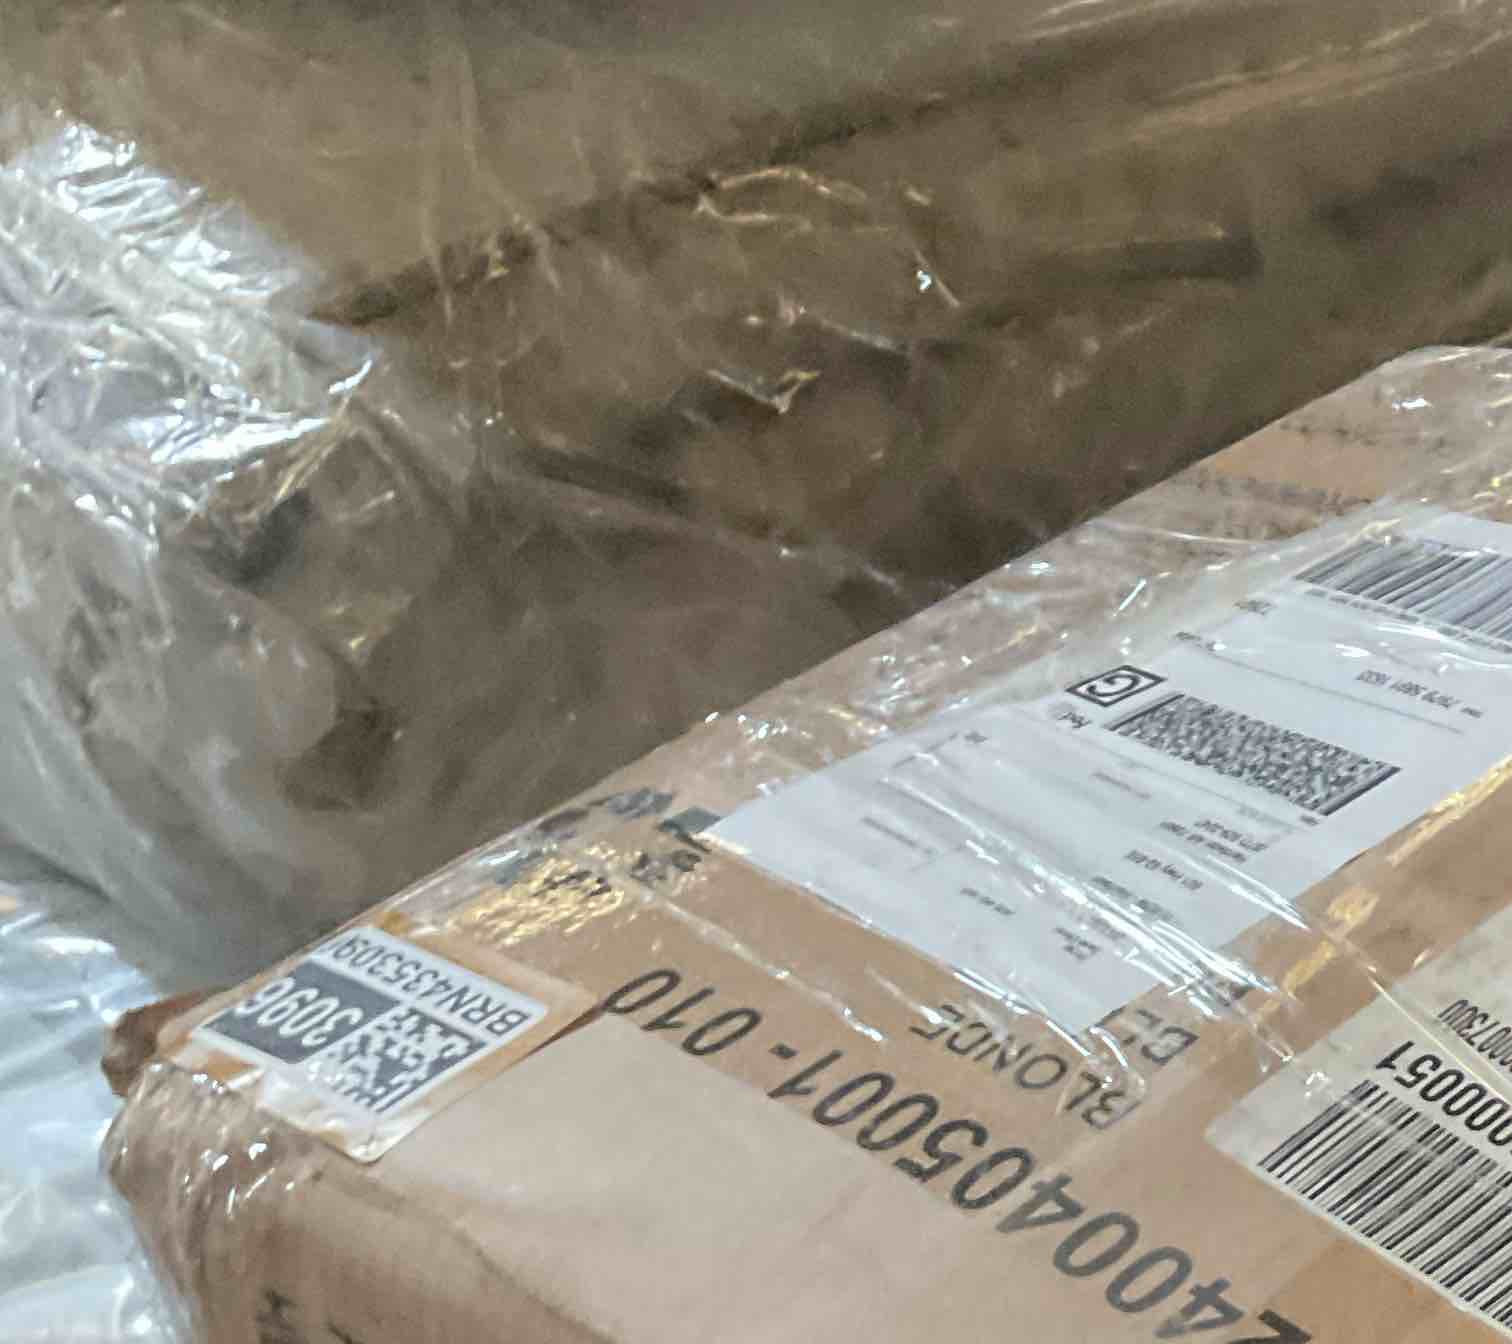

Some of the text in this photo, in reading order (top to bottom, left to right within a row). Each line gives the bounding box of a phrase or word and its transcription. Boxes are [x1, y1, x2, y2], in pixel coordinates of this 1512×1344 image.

[231, 972, 368, 1050] 3096
[318, 930, 530, 1036] BRN435309
[904, 1001, 1144, 1131] BLONDE
